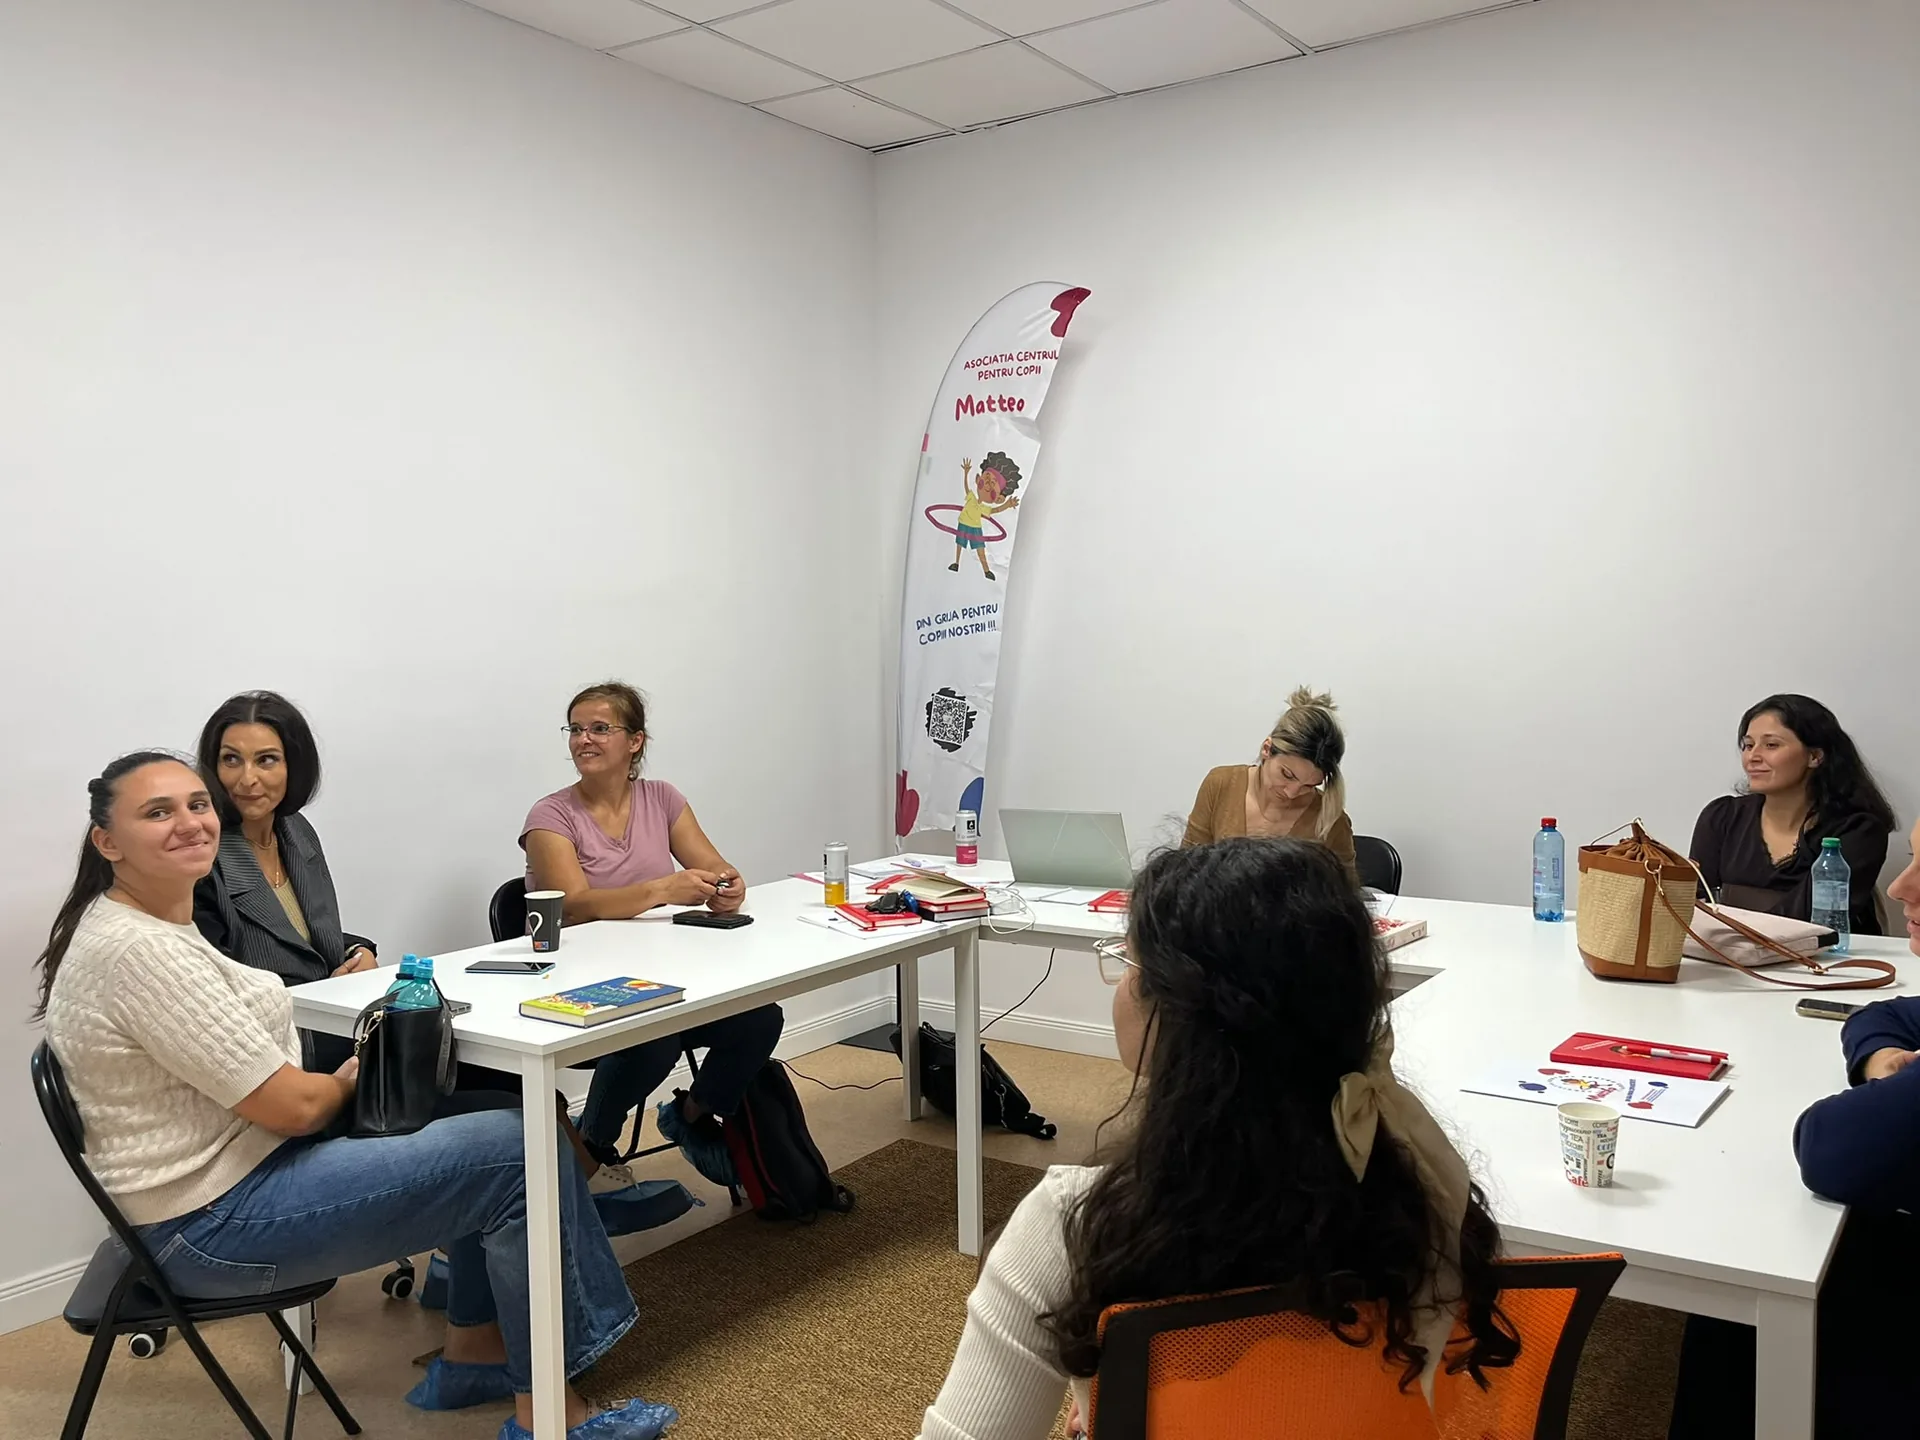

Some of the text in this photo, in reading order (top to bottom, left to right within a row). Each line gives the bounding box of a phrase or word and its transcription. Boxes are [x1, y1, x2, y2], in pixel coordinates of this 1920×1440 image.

[963, 350, 1059, 371] ASOCIATIA CENTRUL
[977, 365, 1042, 381] PENTRU COPII
[955, 394, 1025, 422] Matteo
[934, 610, 960, 625] GRIJA
[961, 603, 998, 620] PENTRU
[1569, 1133, 1585, 1144] TEA
